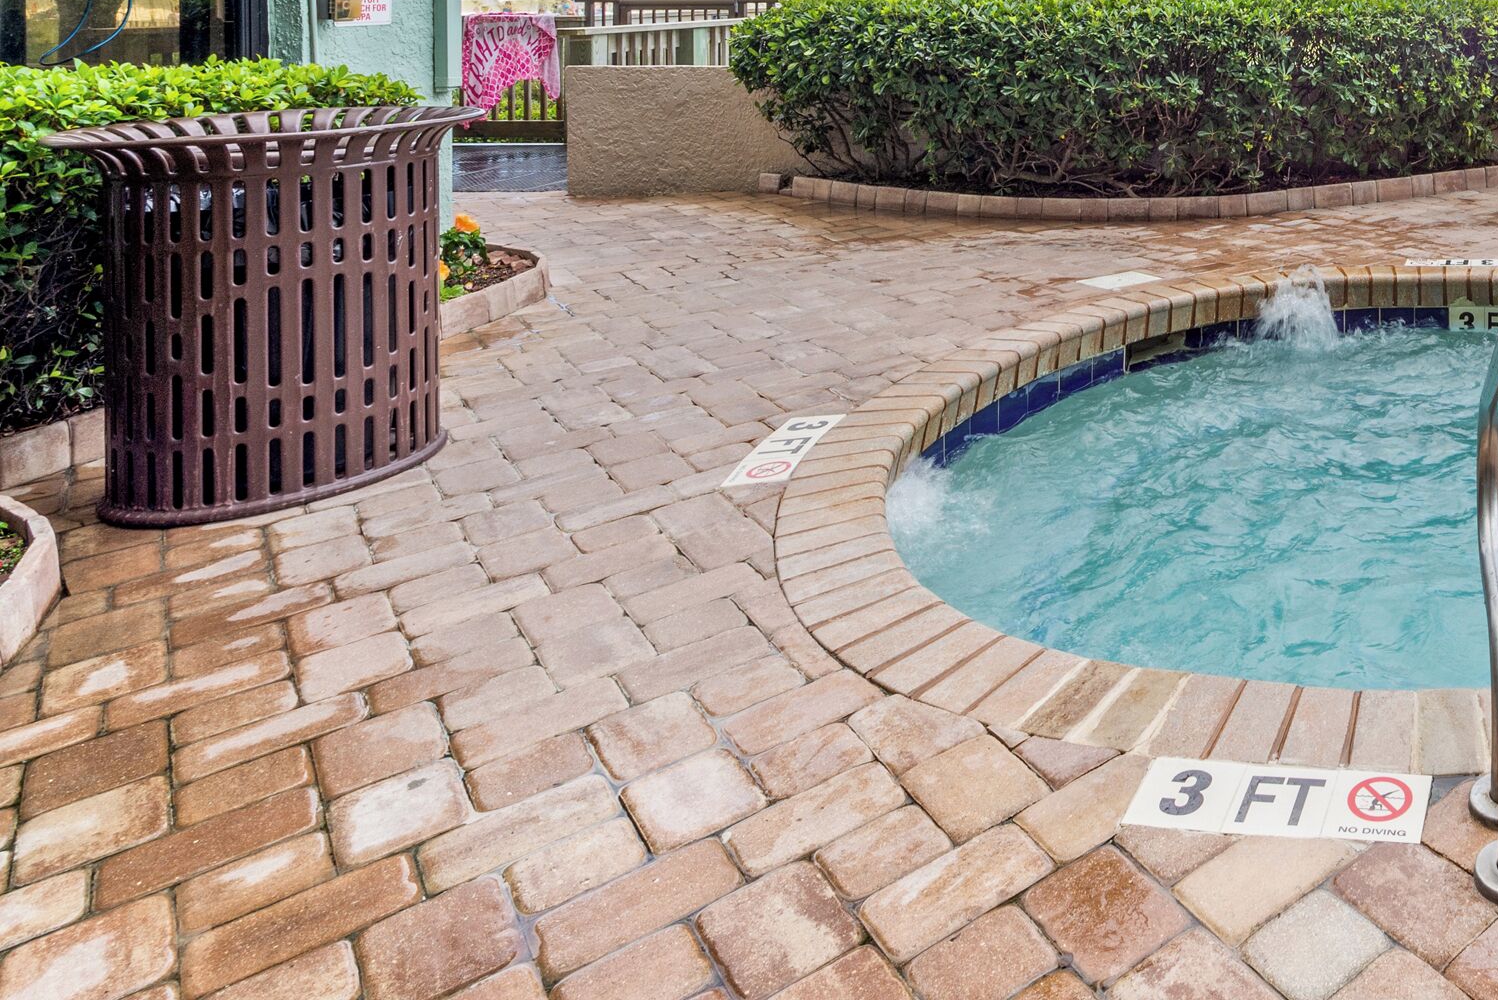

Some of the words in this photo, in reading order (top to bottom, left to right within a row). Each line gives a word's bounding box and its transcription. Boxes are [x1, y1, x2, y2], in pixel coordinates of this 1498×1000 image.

[372, 4, 387, 12] FOR
[1459, 312, 1475, 330] 3
[787, 420, 829, 432] 3
[757, 436, 813, 455] FT
[1158, 769, 1213, 816] 3
[1233, 775, 1327, 826] FT
[1338, 826, 1358, 834] NO
[1362, 828, 1407, 837] DIVING
